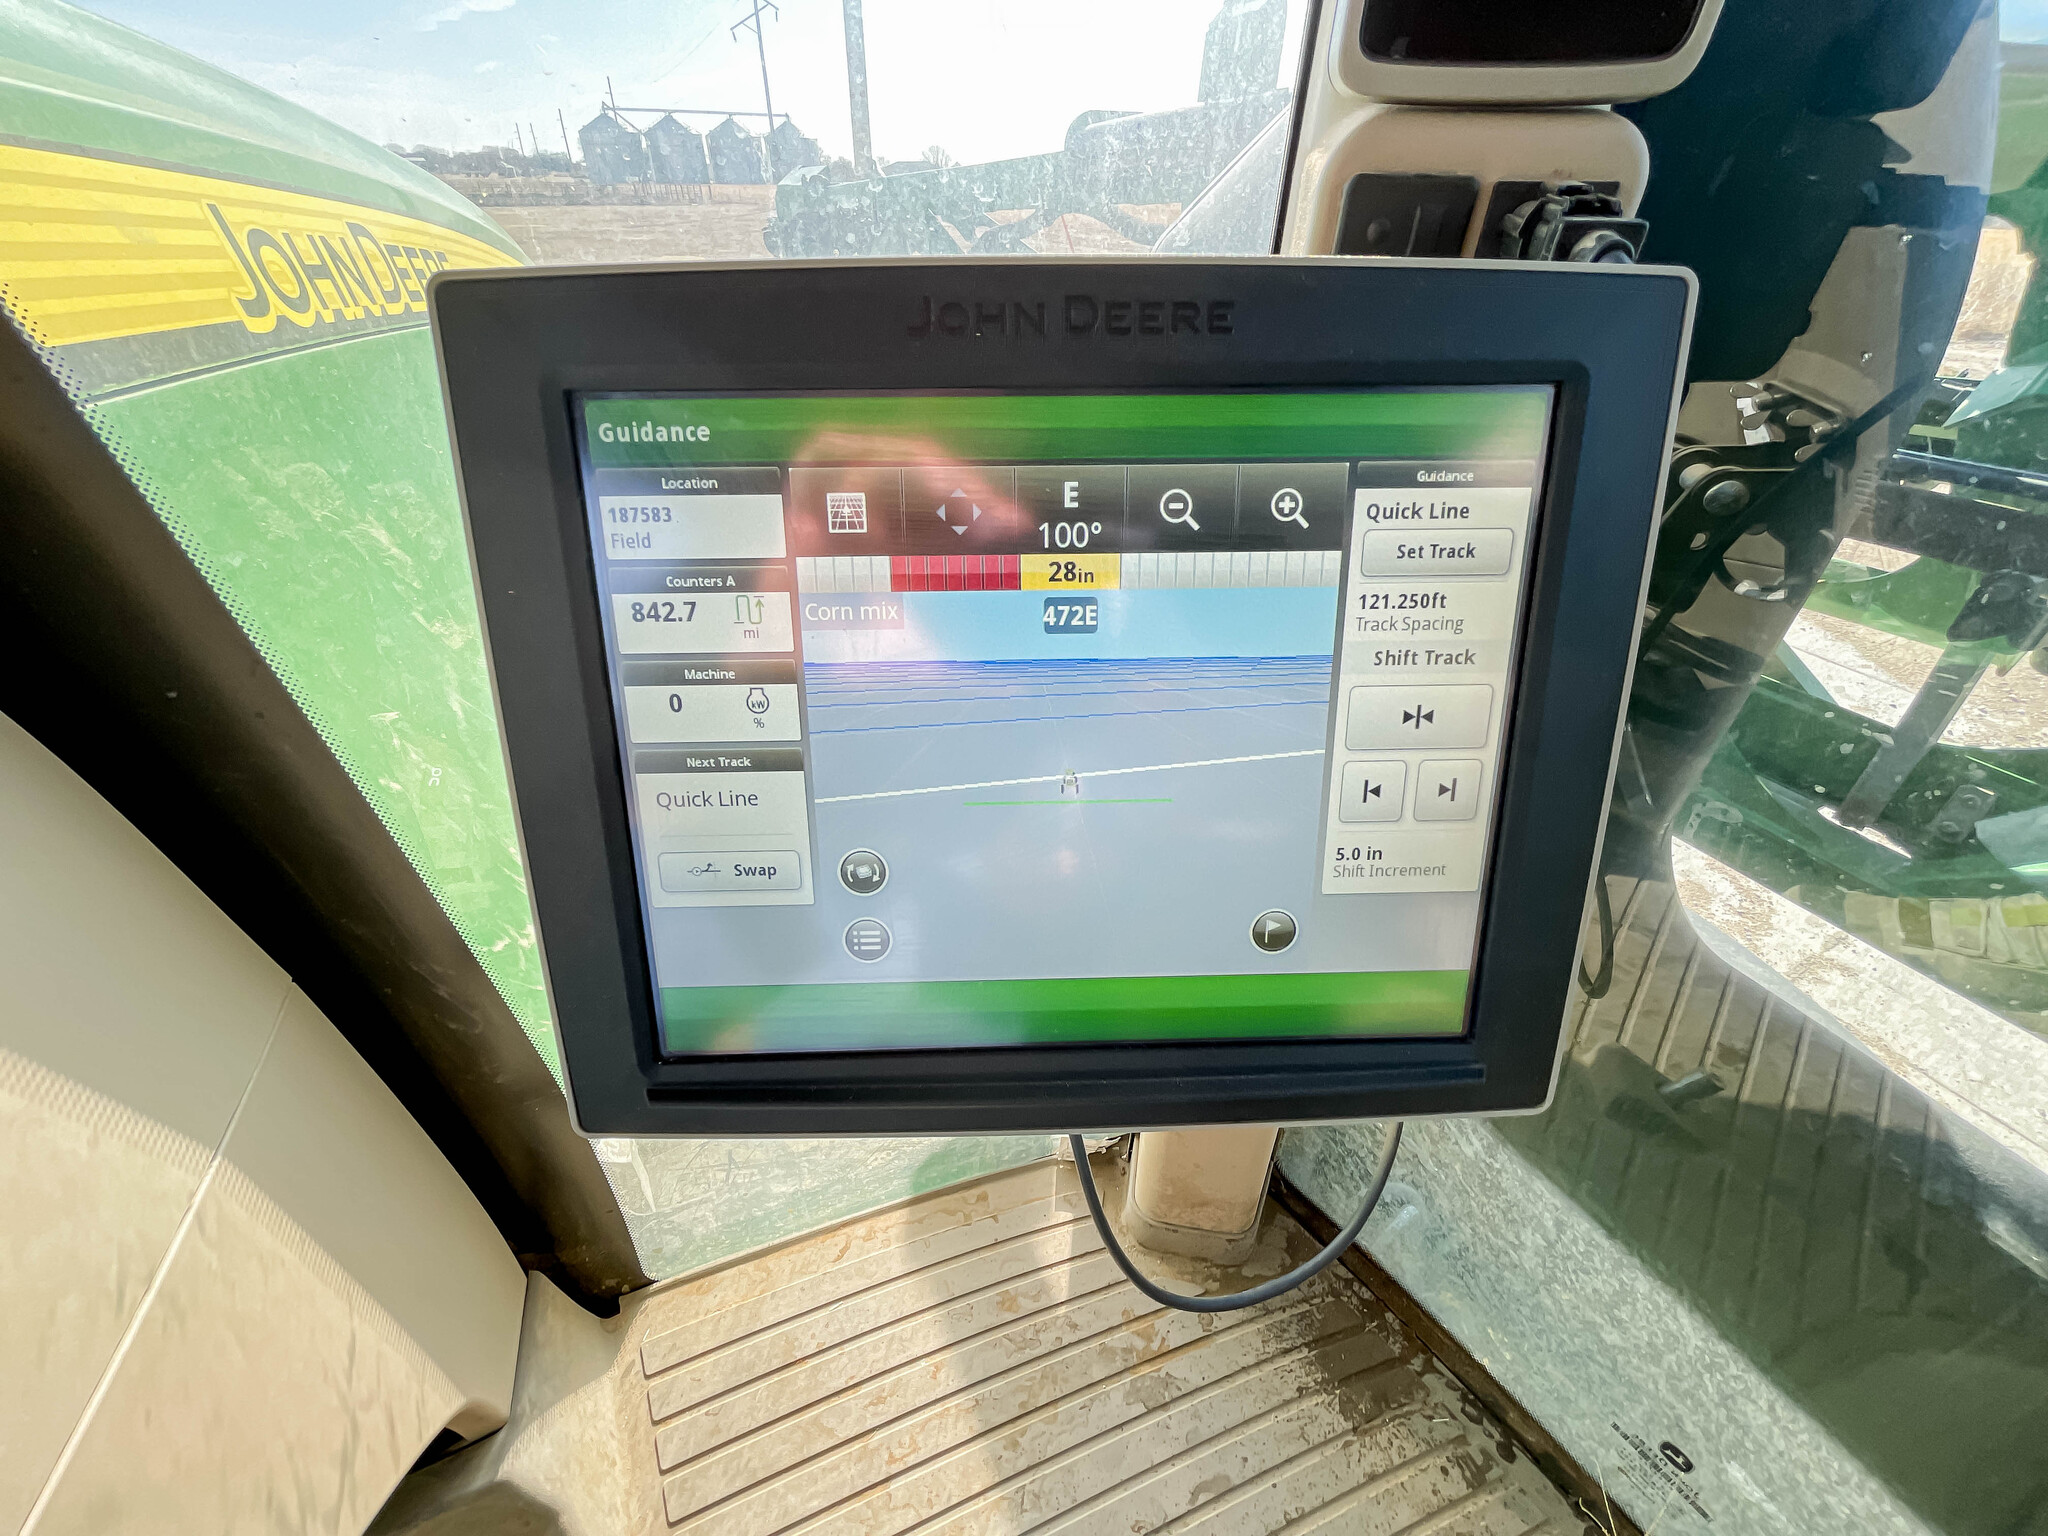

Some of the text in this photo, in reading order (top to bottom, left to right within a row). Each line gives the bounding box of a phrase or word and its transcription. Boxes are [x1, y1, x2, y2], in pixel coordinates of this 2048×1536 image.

[205, 202, 449, 319] JOHN DEE
[907, 294, 1235, 337] JOHN DEERE
[598, 420, 711, 443] Guidance
[661, 476, 719, 490] Location
[1416, 470, 1475, 483] Guidance
[1063, 480, 1080, 508] E
[607, 506, 672, 523] 187583
[1366, 501, 1471, 524] Quick Line
[610, 531, 652, 550] Field
[1038, 521, 1103, 549] 100°
[1396, 542, 1477, 560] Set Track
[665, 575, 736, 589] Counters A
[1358, 592, 1448, 611] 121.250ft
[630, 601, 698, 624] 842.7
[804, 602, 899, 622] Corn mix
[1042, 604, 1098, 627] 472E
[743, 627, 760, 640] mi
[1355, 615, 1465, 635] Track Spacing
[1373, 648, 1477, 667] Shift Track
[684, 668, 736, 681] Machine
[668, 693, 683, 714] 0
[686, 756, 752, 769] Next Track
[656, 790, 759, 812] Quick Line
[1335, 845, 1383, 861] 5.0 in
[733, 863, 778, 880] Swap
[1333, 863, 1447, 878] Shift Increment
